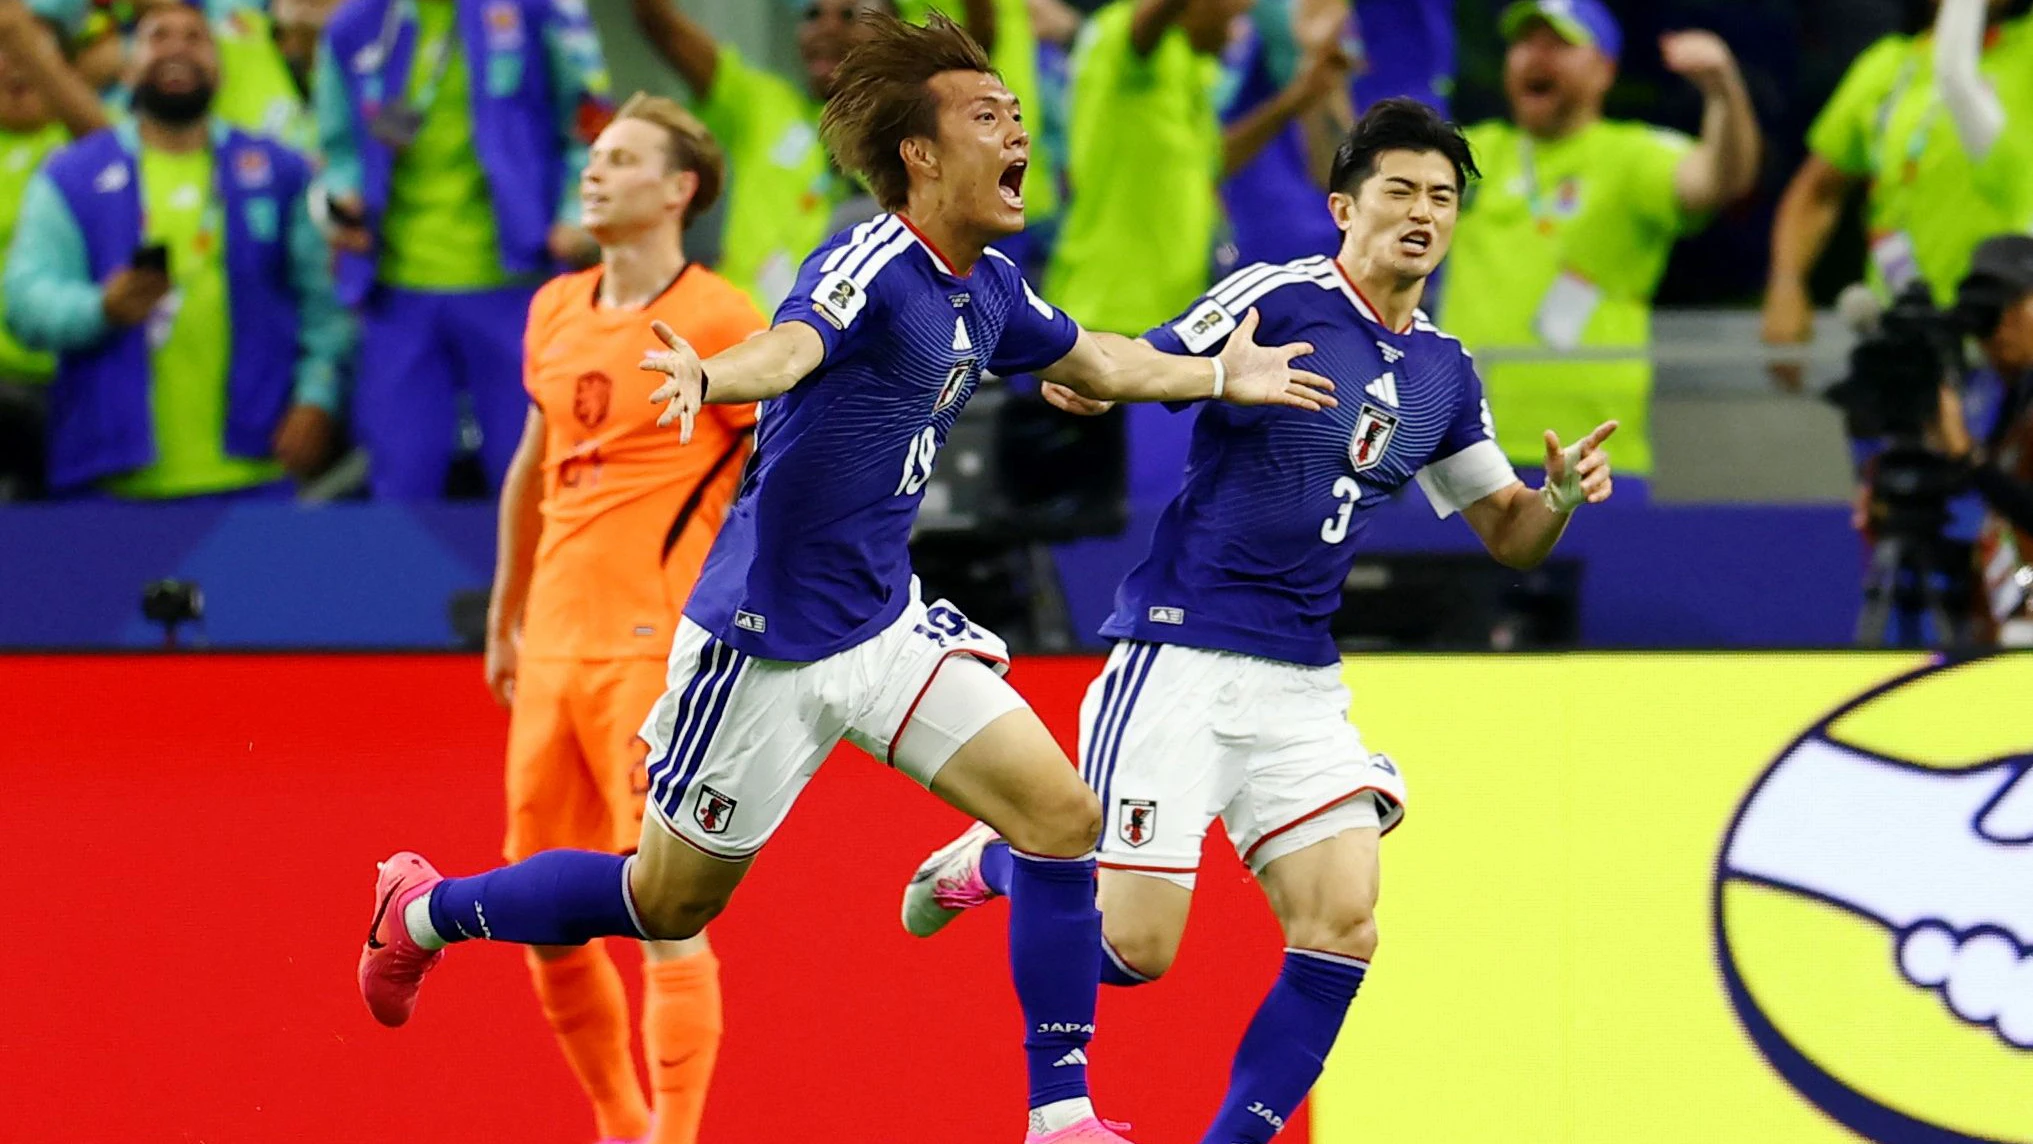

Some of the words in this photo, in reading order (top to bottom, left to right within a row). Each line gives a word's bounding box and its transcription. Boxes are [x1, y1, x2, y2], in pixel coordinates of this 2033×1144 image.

[894, 426, 936, 497] 19
[1320, 475, 1362, 544] 3
[1036, 1022, 1096, 1034] JAPA
